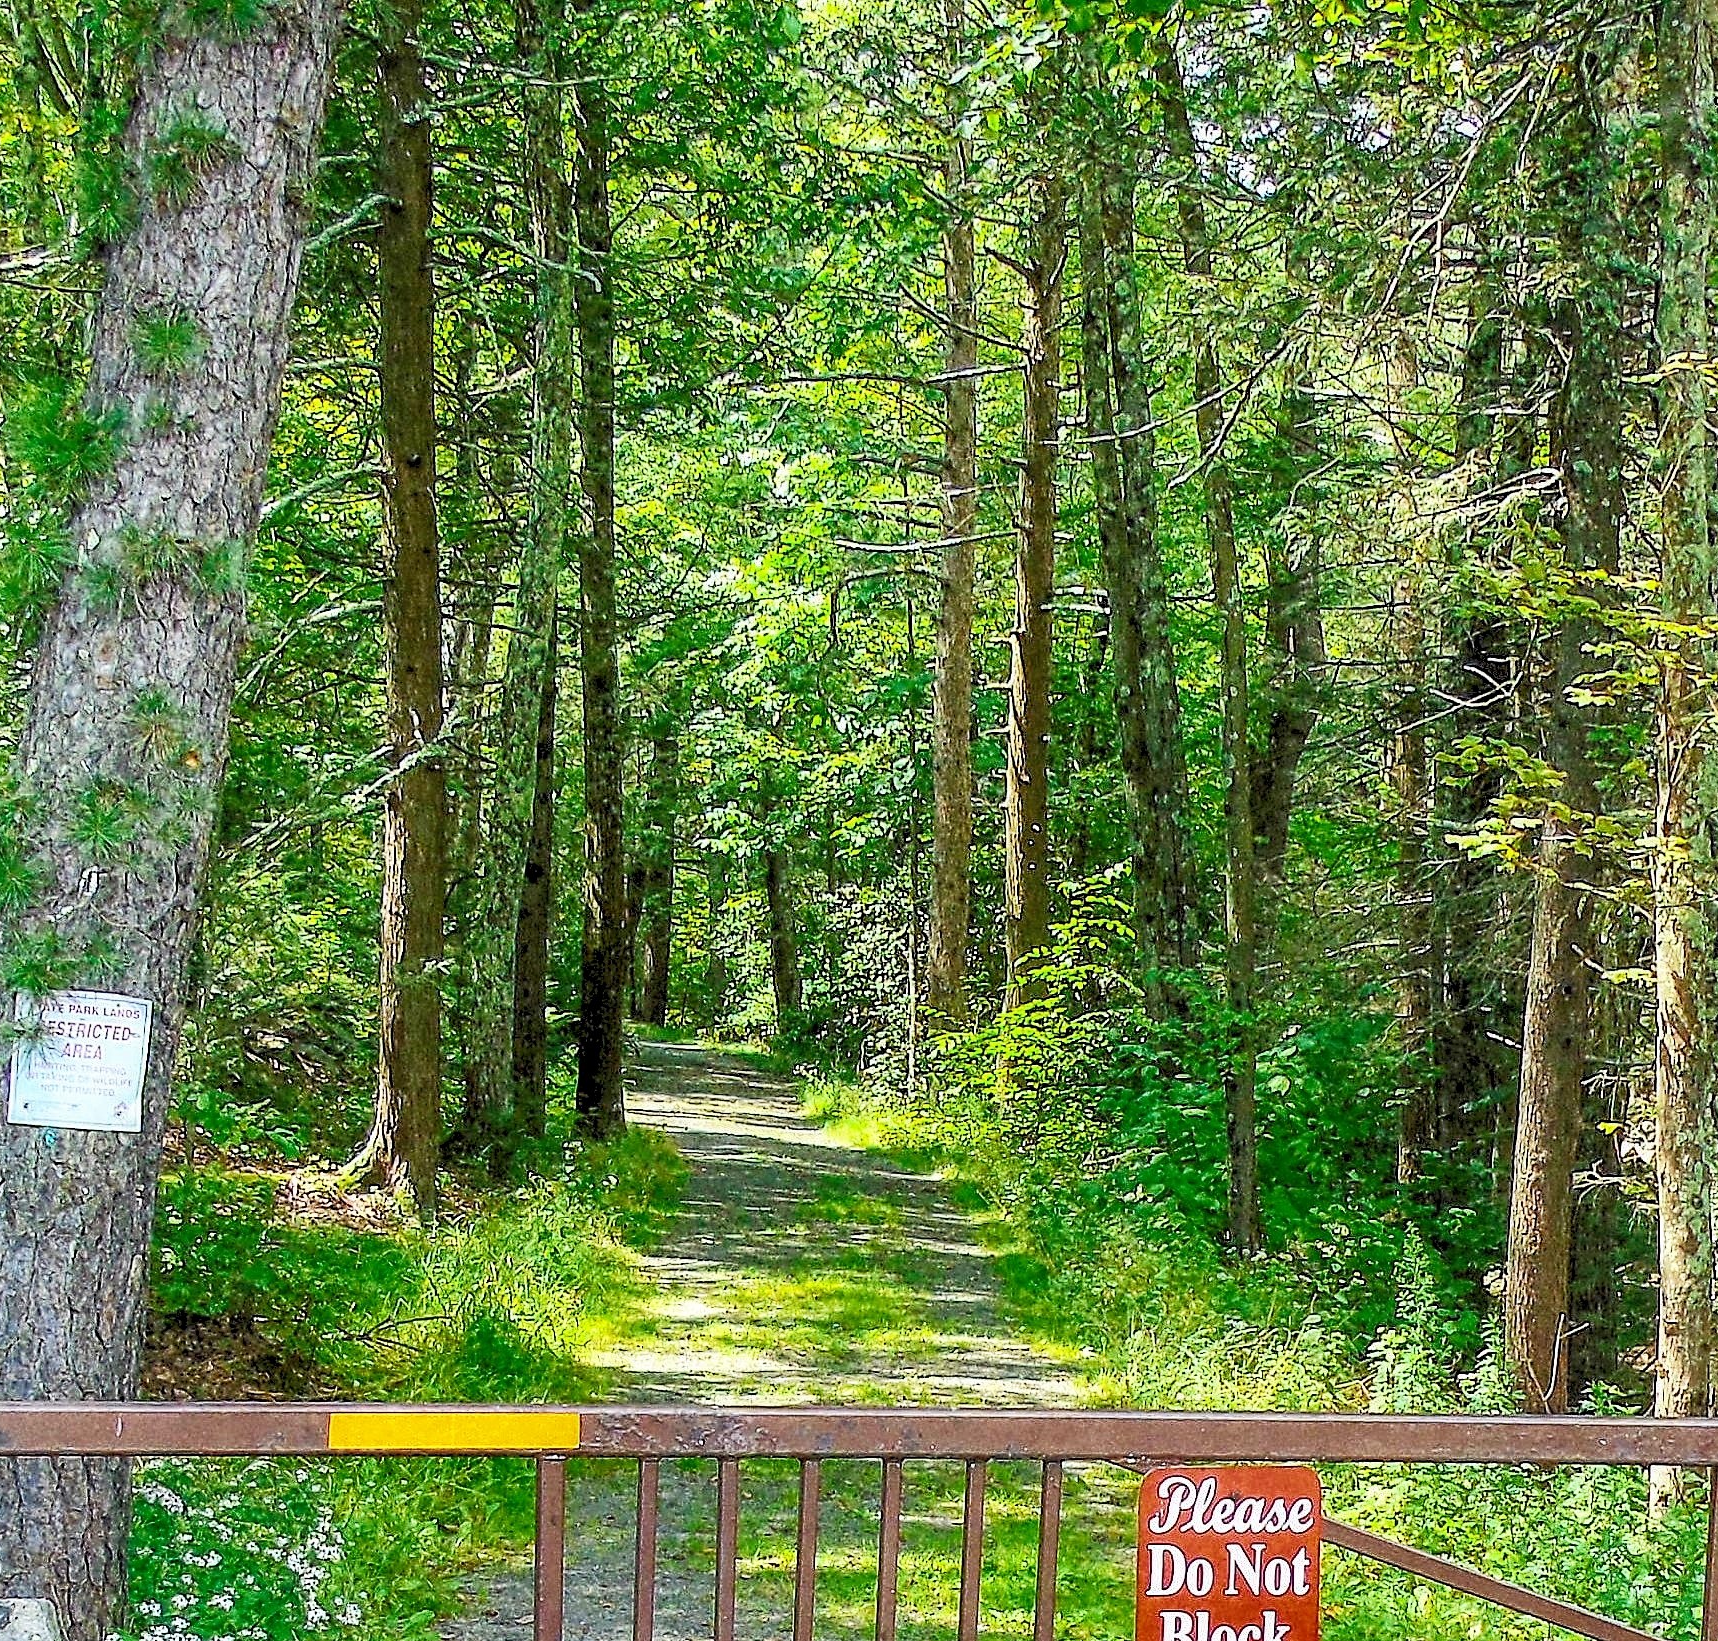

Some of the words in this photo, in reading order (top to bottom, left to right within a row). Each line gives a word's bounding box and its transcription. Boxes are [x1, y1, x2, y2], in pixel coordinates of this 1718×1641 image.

[69, 1004, 99, 1016] PARK
[103, 1007, 140, 1019] LANDS
[63, 1043, 102, 1060] AREA
[1148, 1475, 1315, 1534] Please
[1145, 1543, 1214, 1597] Do
[1224, 1543, 1311, 1597] Not
